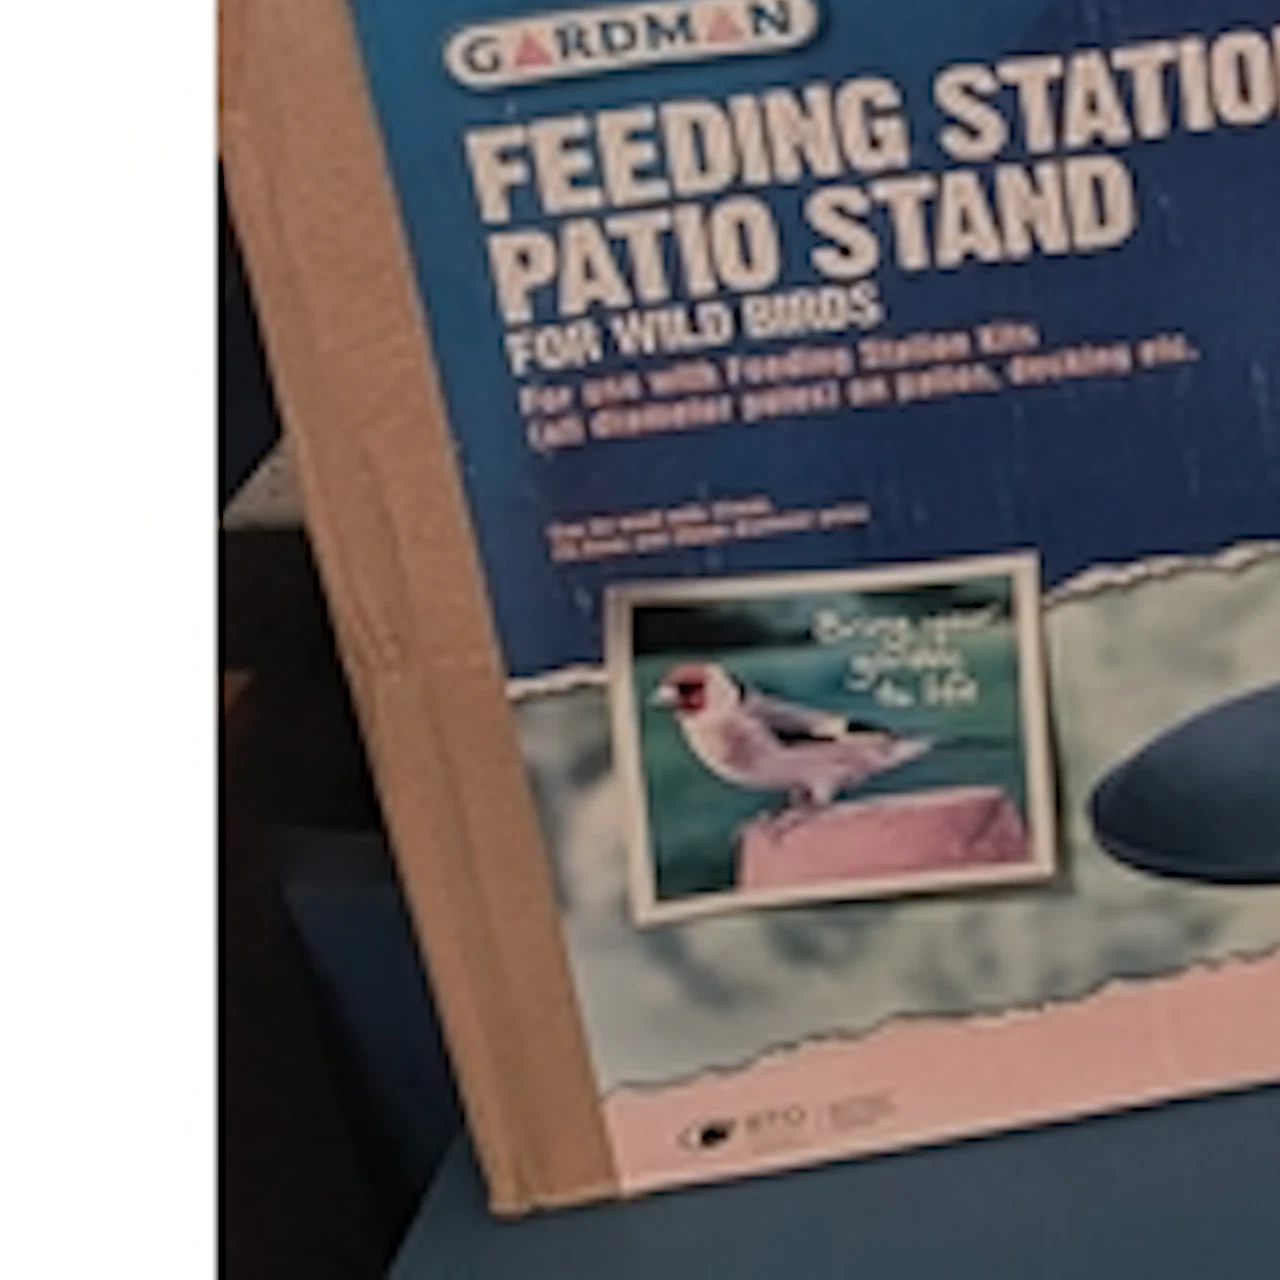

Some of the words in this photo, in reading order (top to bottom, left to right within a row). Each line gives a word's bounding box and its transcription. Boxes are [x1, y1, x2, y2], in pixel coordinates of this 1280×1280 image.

[466, 79, 912, 223] FEEDING
[488, 198, 781, 321] PATIO
[808, 157, 1136, 280] STAND
[505, 320, 602, 376] FOR
[610, 299, 733, 356] WILD
[743, 282, 886, 338] BIRDS
[519, 385, 572, 415] For
[581, 373, 641, 407] use
[649, 360, 719, 391] with
[727, 344, 851, 384] Feeding
[857, 330, 971, 368] Station
[975, 320, 1041, 354] Kits
